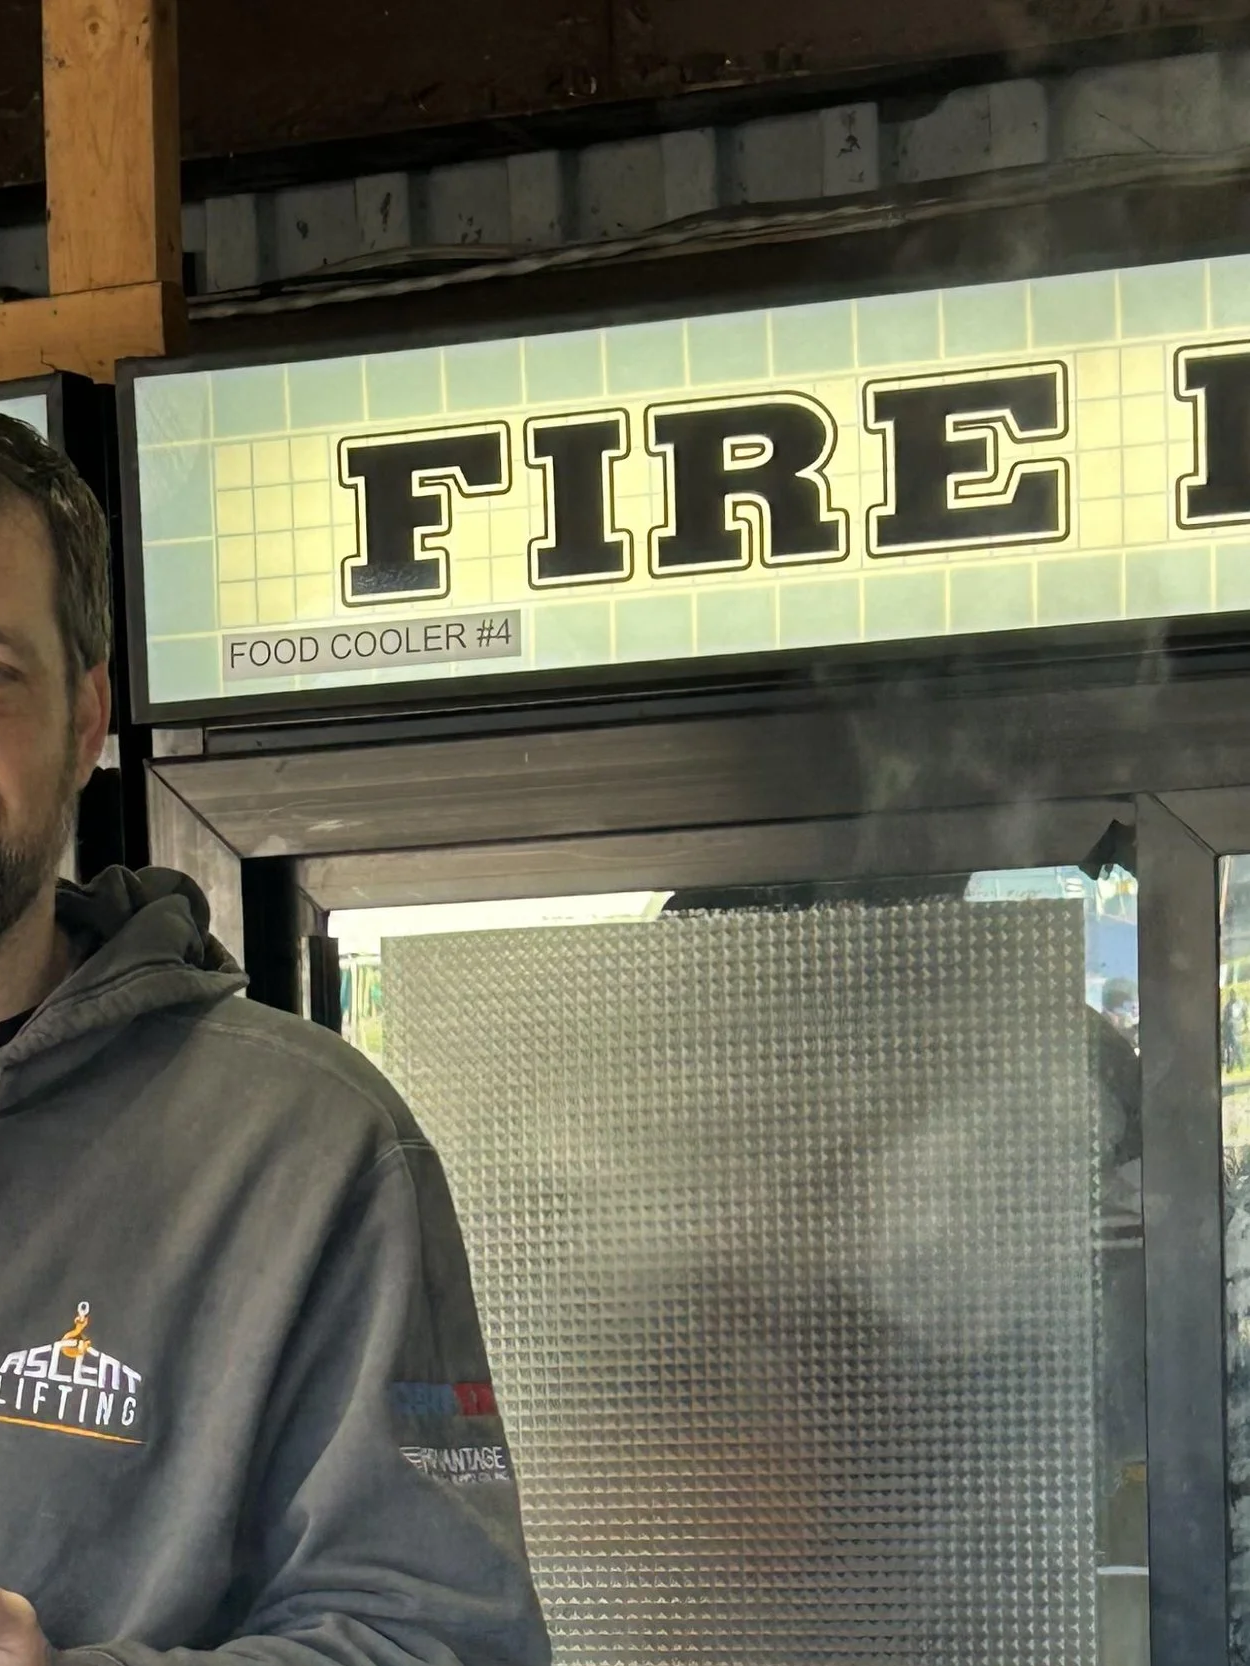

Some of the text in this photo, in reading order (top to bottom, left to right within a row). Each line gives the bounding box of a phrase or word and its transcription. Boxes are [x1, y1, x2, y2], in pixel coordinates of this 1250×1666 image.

[340, 359, 1070, 607] FIRE
[230, 618, 512, 668] FOOD COOLER #4
[0, 1339, 142, 1394] ASCENT
